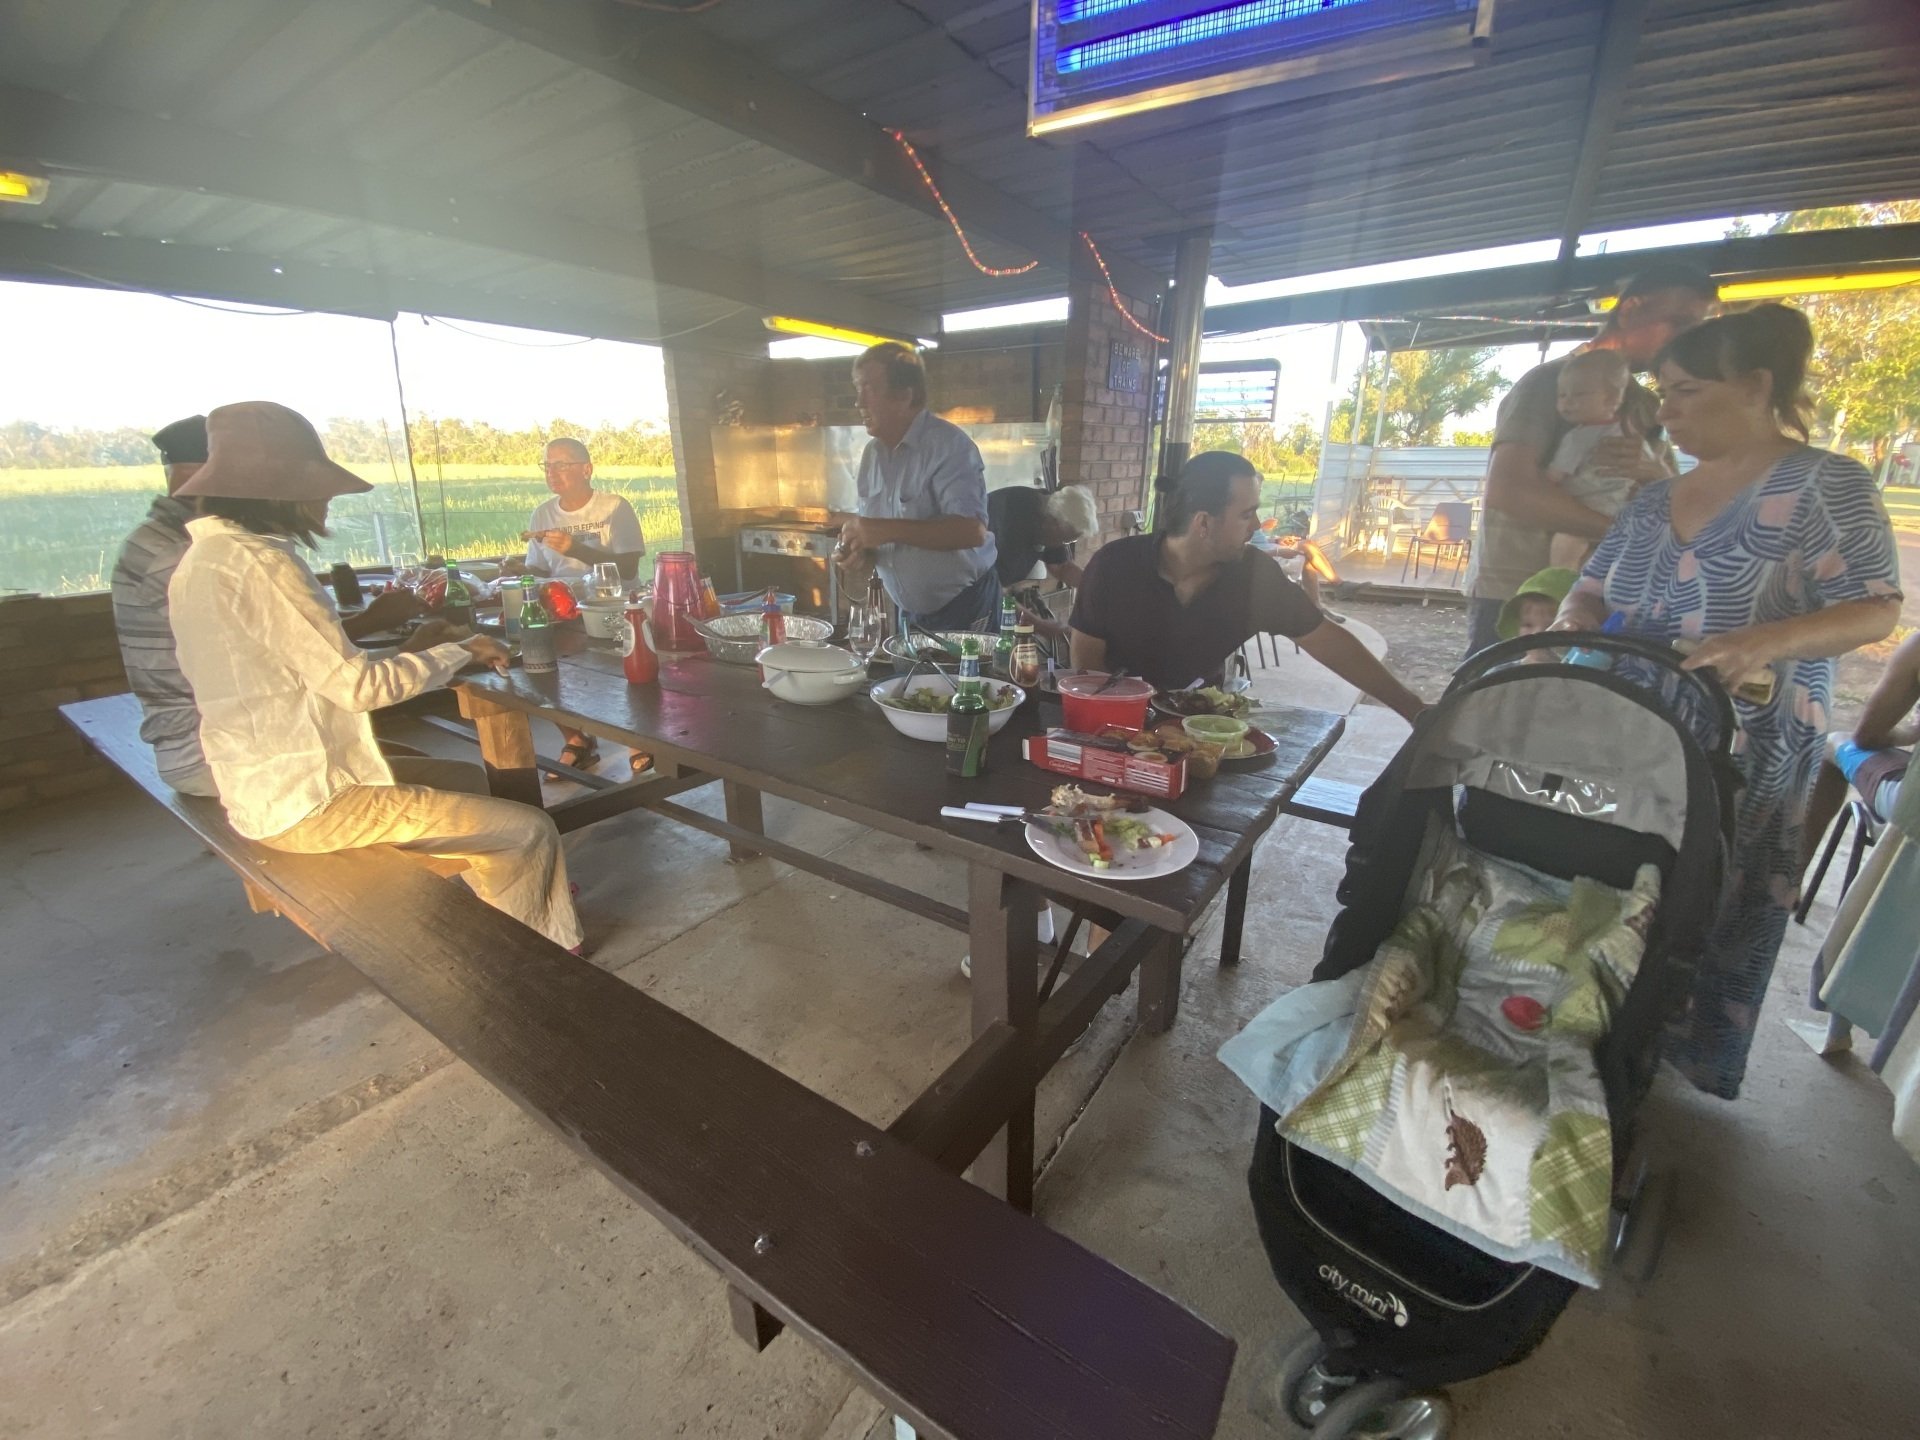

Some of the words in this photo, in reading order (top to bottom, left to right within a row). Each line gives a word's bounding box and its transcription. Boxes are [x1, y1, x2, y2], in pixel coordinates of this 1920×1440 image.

[1114, 342, 1141, 360] BEWARE
[1122, 360, 1131, 371] OF
[1113, 375, 1137, 390] TRAINS
[573, 521, 604, 532] SLEEPING
[1319, 1265, 1349, 1290] city
[1350, 1284, 1388, 1314] mini
